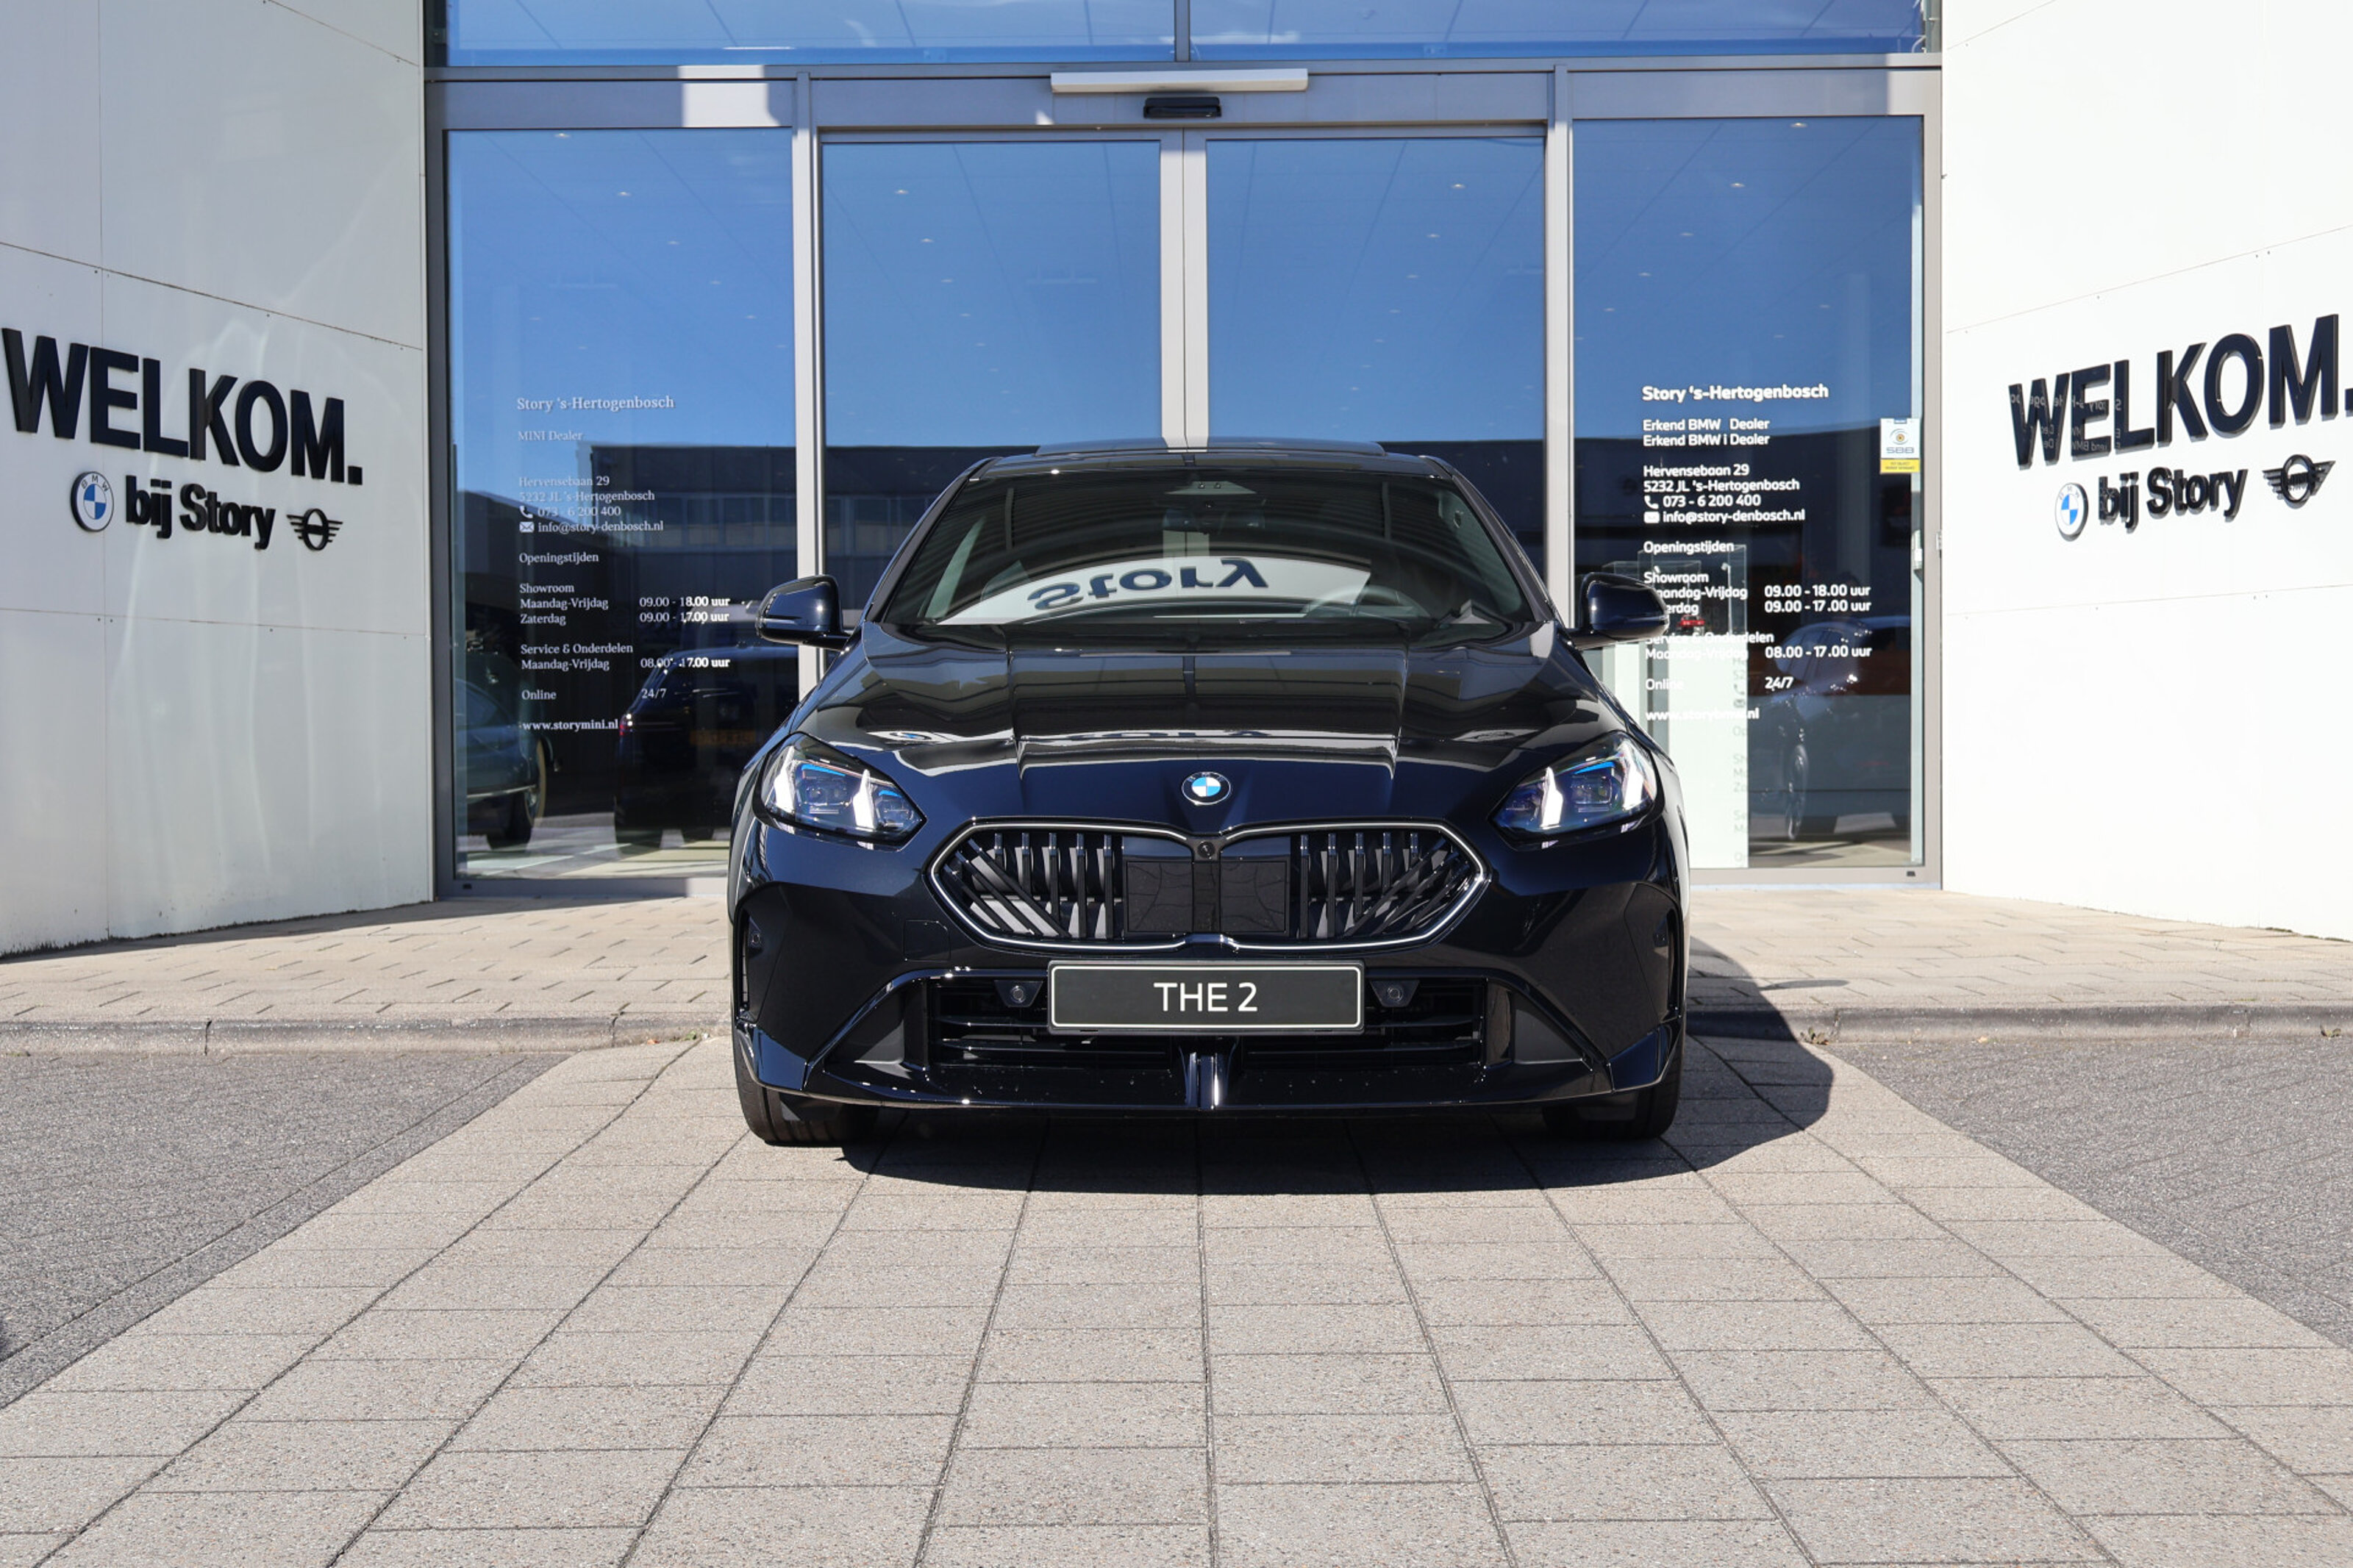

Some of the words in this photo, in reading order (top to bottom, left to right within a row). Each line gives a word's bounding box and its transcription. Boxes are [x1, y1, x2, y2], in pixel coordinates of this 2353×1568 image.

[1642, 386, 1686, 404] Story
[2008, 314, 2353, 470] WELKOM.
[2, 328, 363, 485] WELKOM.
[517, 398, 553, 413] Story
[1643, 419, 1685, 432] Erkend
[1688, 418, 1721, 431] BMW
[1729, 418, 1770, 430] Dealer
[518, 431, 545, 441] MINI
[549, 430, 583, 441] Dealer
[1643, 434, 1685, 446] Erkend
[1688, 434, 1721, 445] BMW
[1723, 433, 1727, 445] i
[1729, 433, 1771, 445] Dealer
[1643, 465, 1731, 477] Hervensebaan
[1732, 464, 1750, 476] 29
[519, 476, 593, 487] Hervensebaan
[596, 476, 610, 486] 29
[1643, 480, 1674, 493] 5232
[1676, 480, 1690, 493] JL
[519, 492, 546, 503] 5232
[549, 492, 562, 502] JL
[1663, 495, 1686, 507] 073
[1697, 495, 1706, 507] 6
[1708, 494, 1733, 506] 200
[1735, 494, 1761, 506] 400
[2099, 471, 2139, 534] bij
[2146, 467, 2249, 522] Story
[126, 475, 172, 539] bij
[180, 484, 276, 550] Story
[538, 506, 558, 518] 073
[568, 506, 575, 517] 6
[578, 506, 598, 517] 200
[600, 506, 621, 517] 400
[1663, 509, 1805, 524] info@story-denbosch.nl
[538, 520, 664, 535] info@story-denbosch.nl
[1643, 540, 1735, 555] Openingstijden
[519, 551, 599, 565] Openingstijden
[1644, 572, 1710, 584] Showroom
[519, 583, 575, 594] Showroom
[1657, 586, 1748, 601] andag-Vrijdag
[1764, 584, 1802, 597] 09.00
[1812, 584, 1847, 597] 18.00
[1850, 587, 1871, 596] uur
[520, 597, 609, 611] Maandag-Vrijdag
[639, 597, 670, 607] 09.00
[679, 596, 709, 607] 18.00
[711, 598, 730, 606] uur
[1667, 602, 1699, 616] erdag
[1764, 600, 1802, 612] 09.00
[1812, 599, 1848, 612] 17.00
[1850, 601, 1872, 612] uur
[520, 613, 566, 626] Zaterdag
[639, 612, 670, 623] 09.00
[680, 612, 708, 623] 17.00
[710, 613, 730, 622] uur
[1704, 631, 1774, 643] Onderdelen
[521, 644, 560, 654] Service
[563, 643, 570, 654] &
[573, 642, 633, 654] Onderdelen
[1765, 645, 1803, 659] 08.00
[1813, 645, 1849, 657] 17.00
[1852, 648, 1872, 657] uur
[521, 659, 610, 671] Maandag-Vrijdag
[640, 657, 671, 667] 08.00
[681, 657, 709, 667] 17.00
[711, 659, 730, 667] uur
[1765, 676, 1794, 690] 24/7
[521, 690, 557, 700] Online
[641, 688, 667, 699] 24/7
[522, 719, 618, 732] www.storymini.nl
[1154, 982, 1229, 1012] THE
[1238, 982, 1258, 1012] 2
